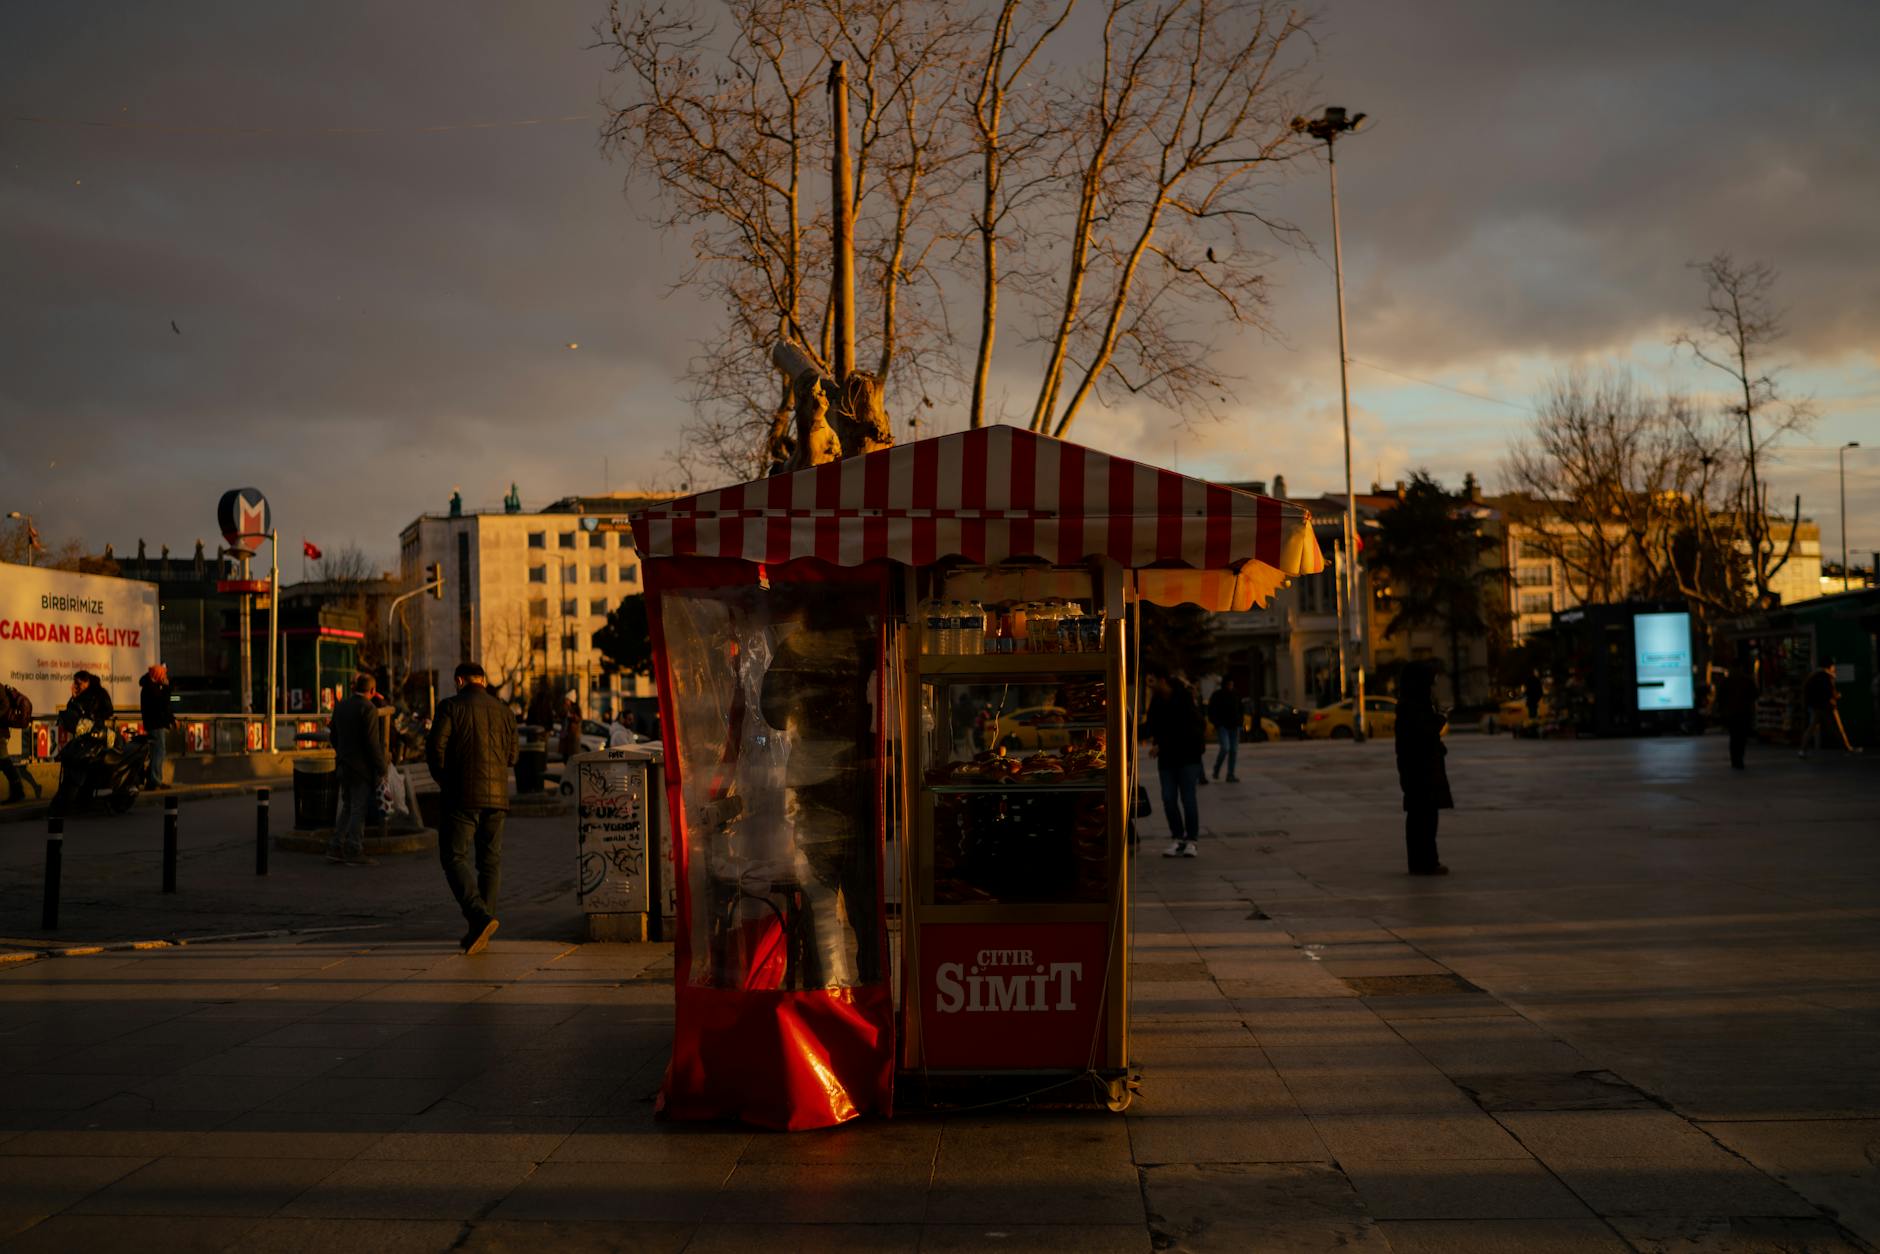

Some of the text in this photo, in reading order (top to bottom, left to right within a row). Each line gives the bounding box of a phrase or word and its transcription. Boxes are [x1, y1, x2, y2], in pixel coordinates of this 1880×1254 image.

[239, 493, 266, 540] M
[41, 592, 104, 614] BİRBİRİMİZE
[0, 619, 70, 643] CANDAN
[74, 623, 140, 648] BAĞLIYIZ
[976, 949, 1035, 972] ÇITIR
